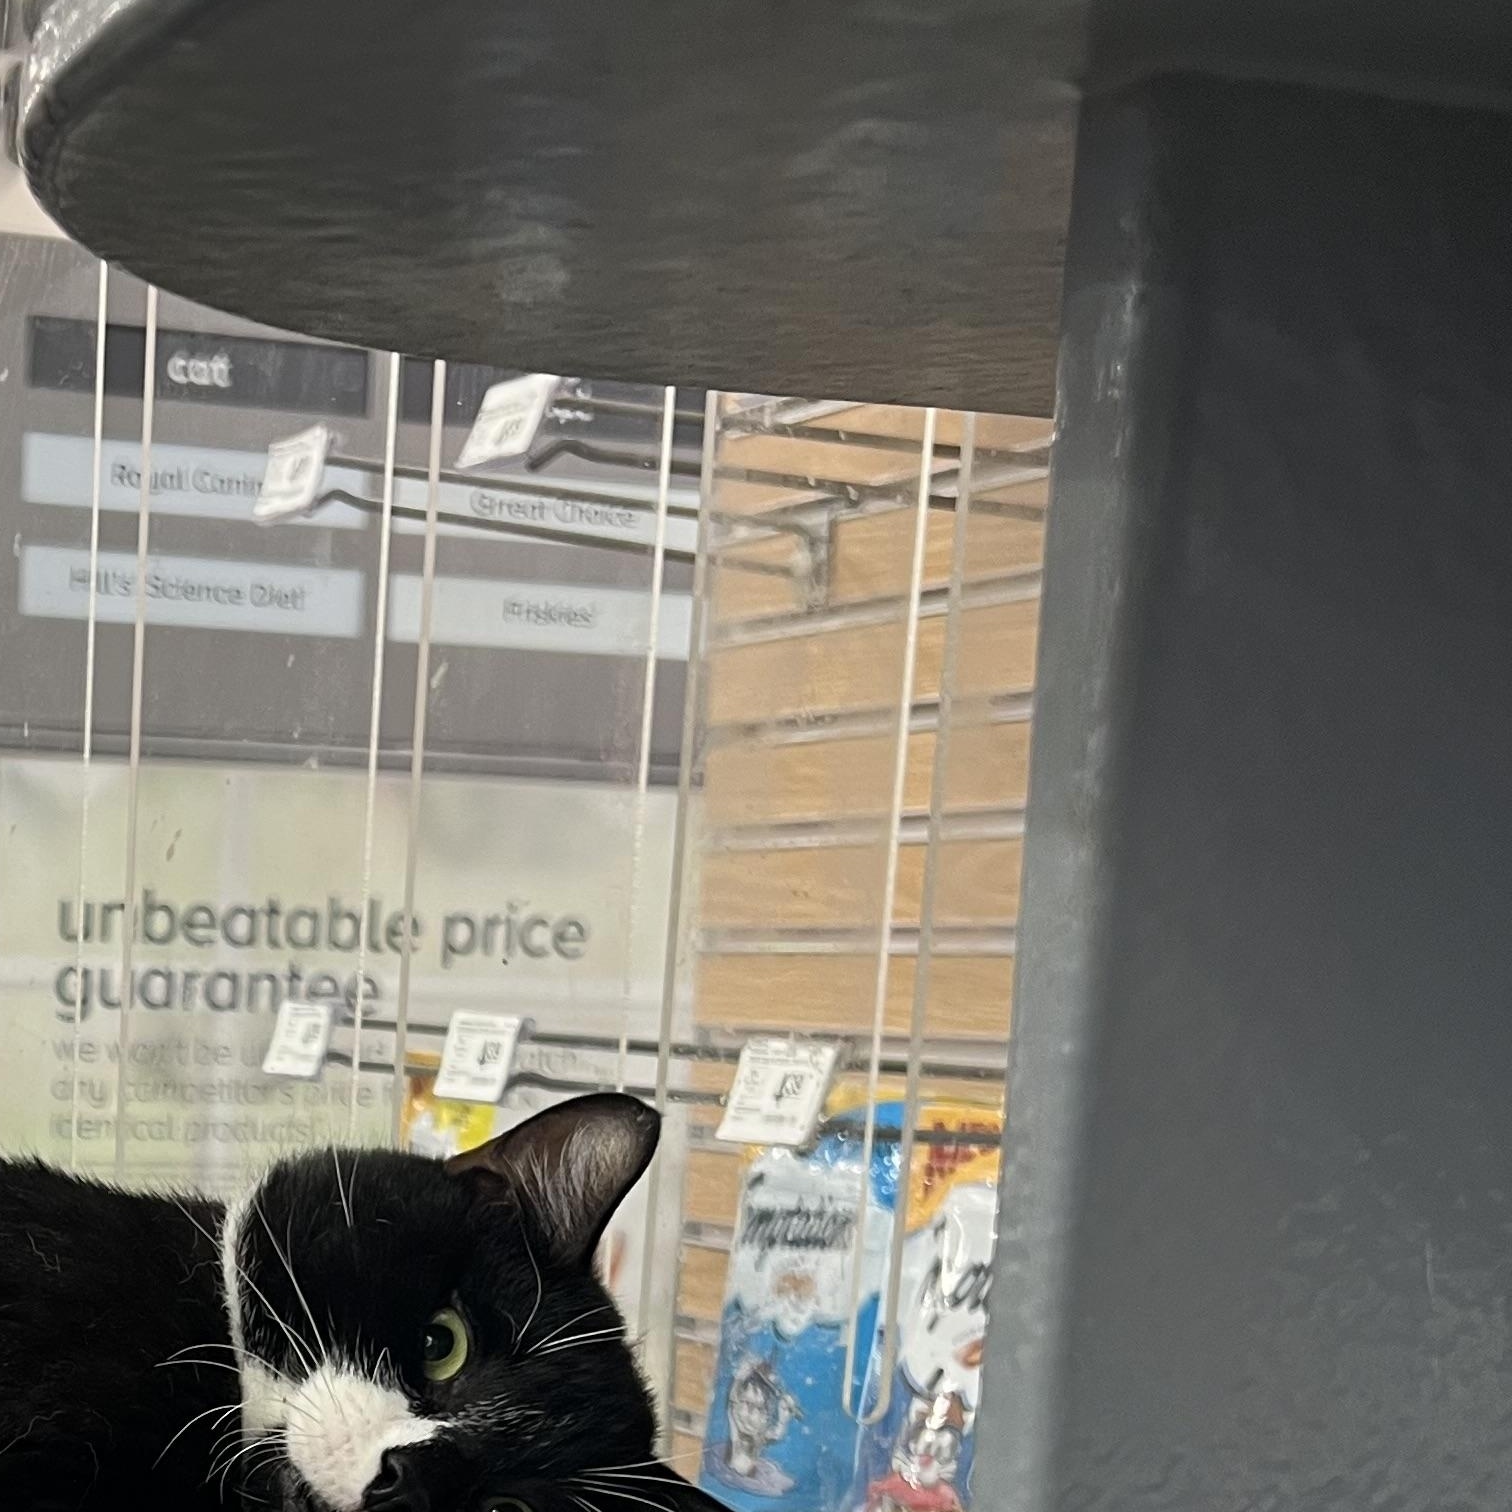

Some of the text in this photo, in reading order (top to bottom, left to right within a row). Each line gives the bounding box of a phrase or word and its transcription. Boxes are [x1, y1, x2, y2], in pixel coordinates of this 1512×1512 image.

[166, 352, 233, 388] cat
[470, 488, 546, 520] Great
[144, 573, 243, 606] Science
[249, 582, 307, 611] Diet
[56, 888, 589, 967] unbeatable price
[53, 961, 382, 1024] guarantee
